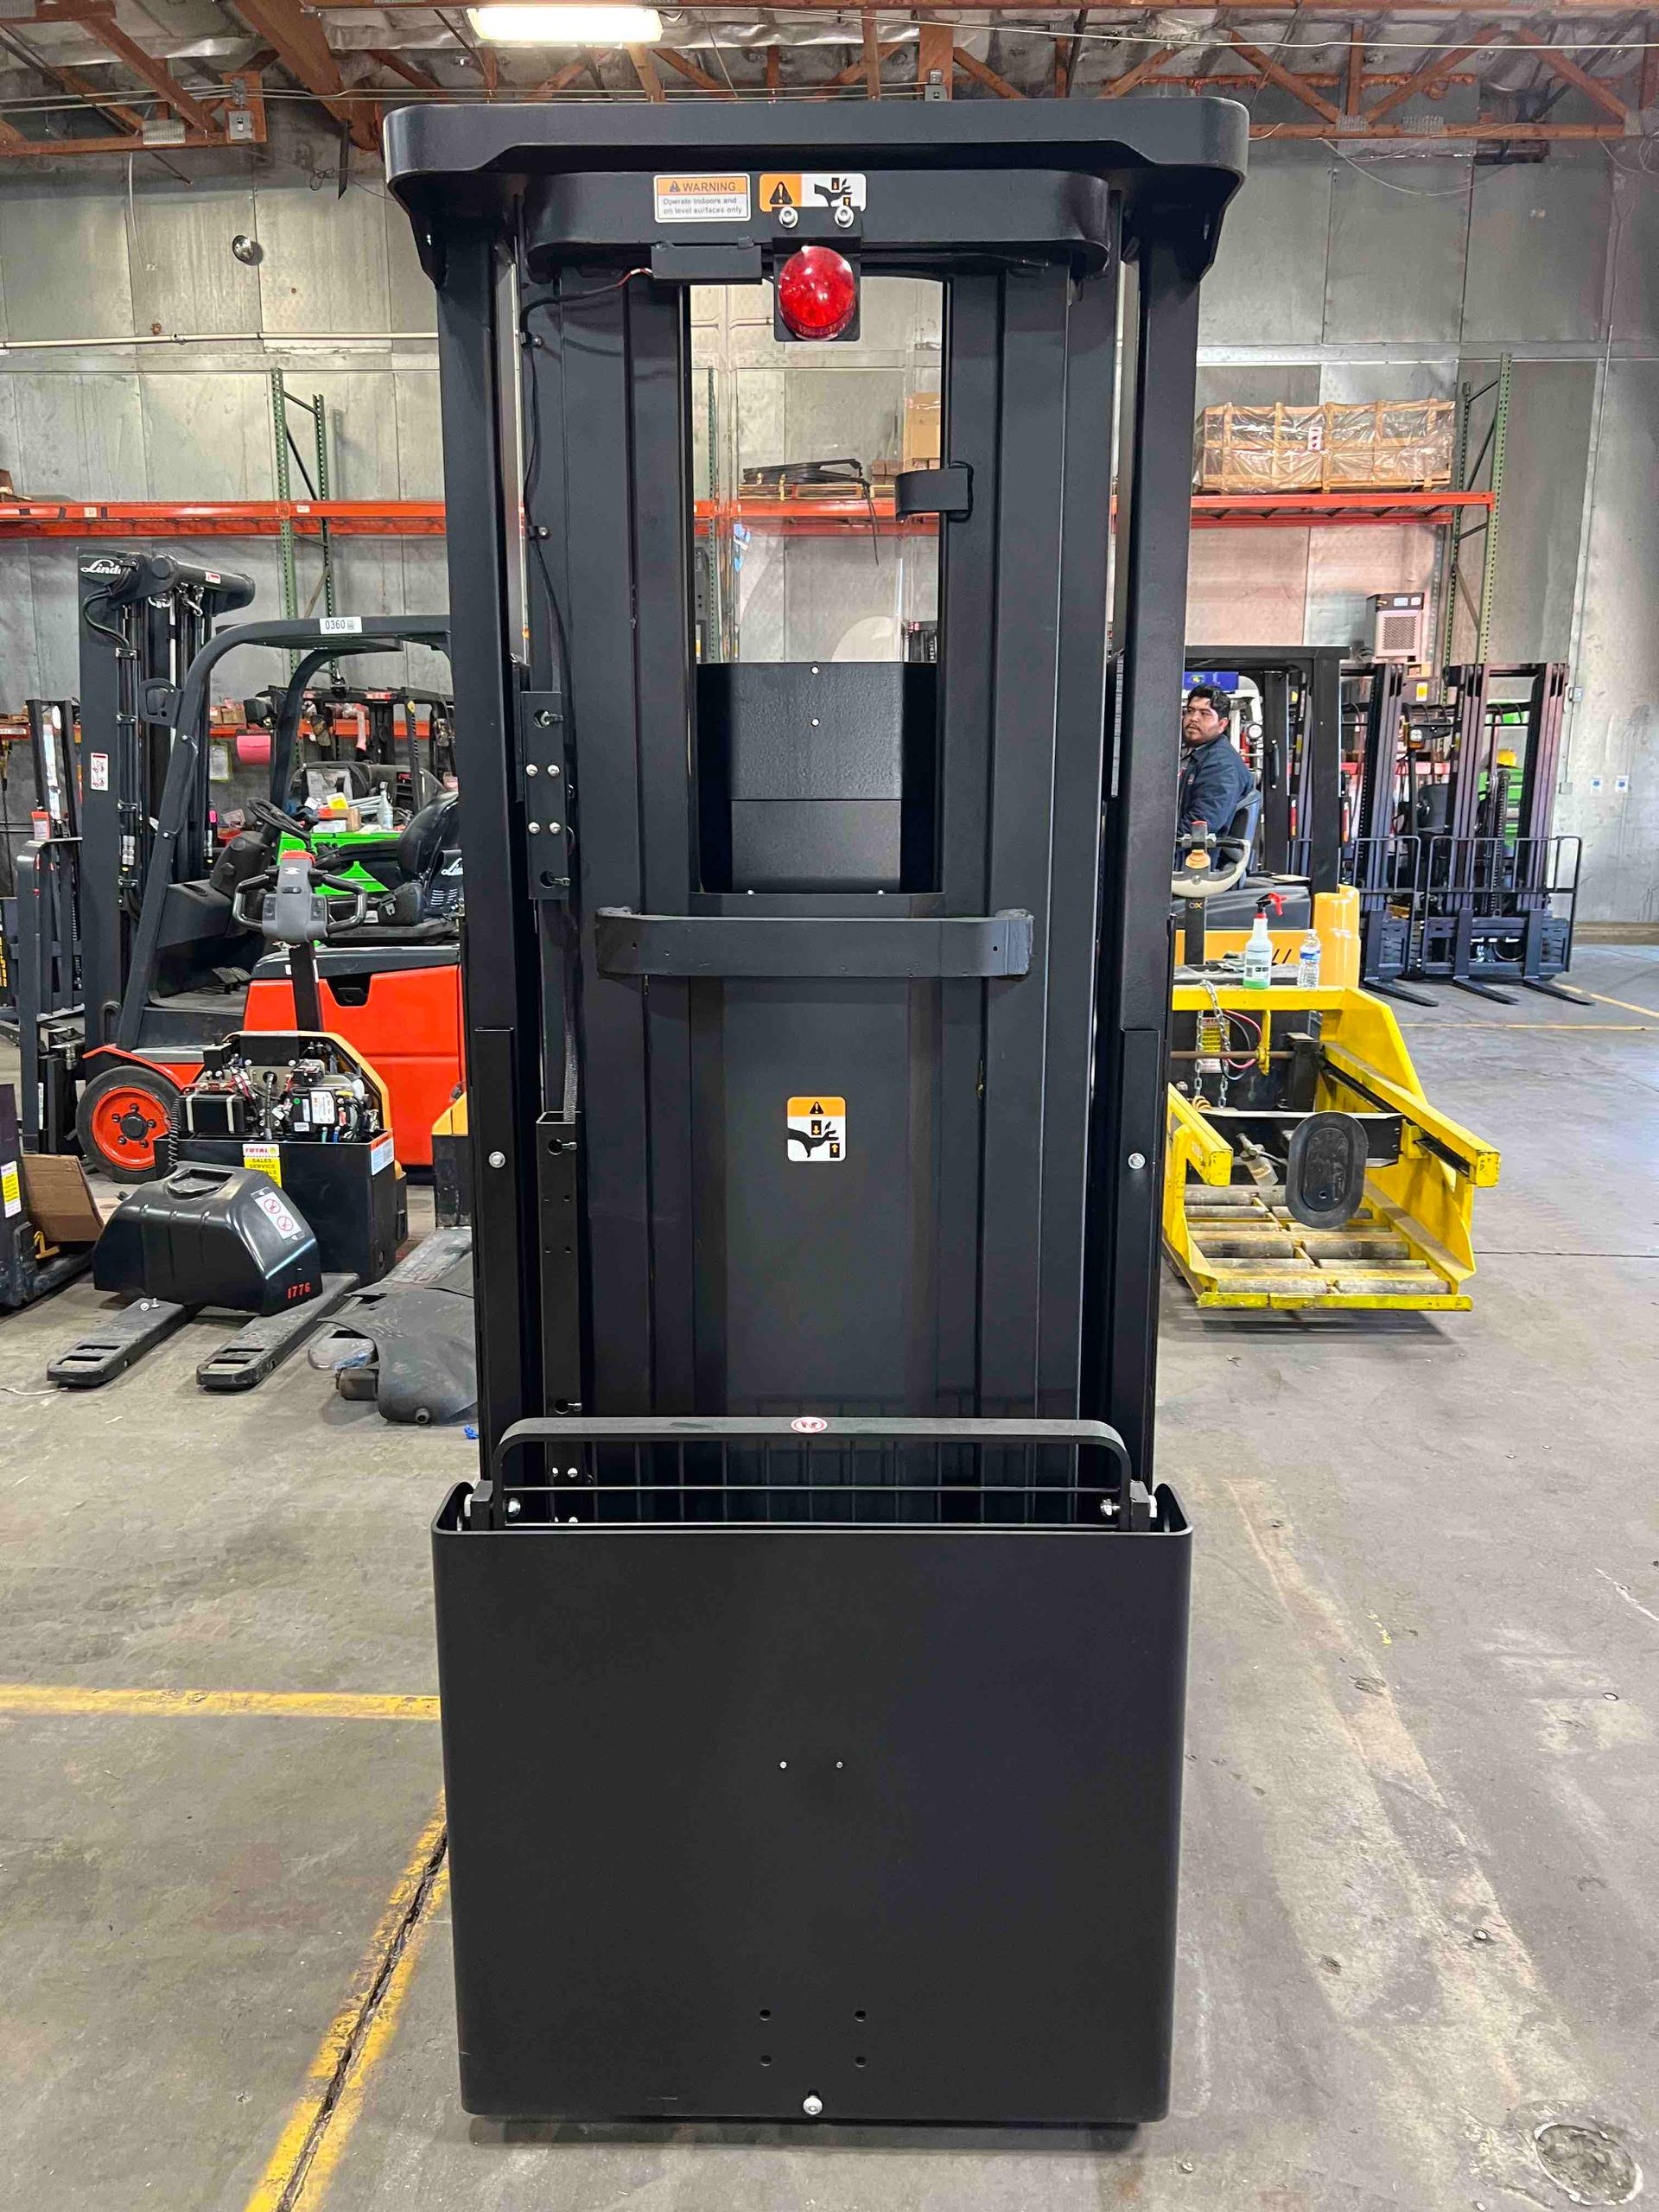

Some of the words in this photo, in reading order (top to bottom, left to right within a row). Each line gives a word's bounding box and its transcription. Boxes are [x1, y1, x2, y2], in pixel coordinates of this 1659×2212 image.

[683, 181, 736, 192] WARNING
[80, 559, 122, 575] Lind
[325, 620, 346, 630] 0360
[287, 1281, 312, 1300] 1776
